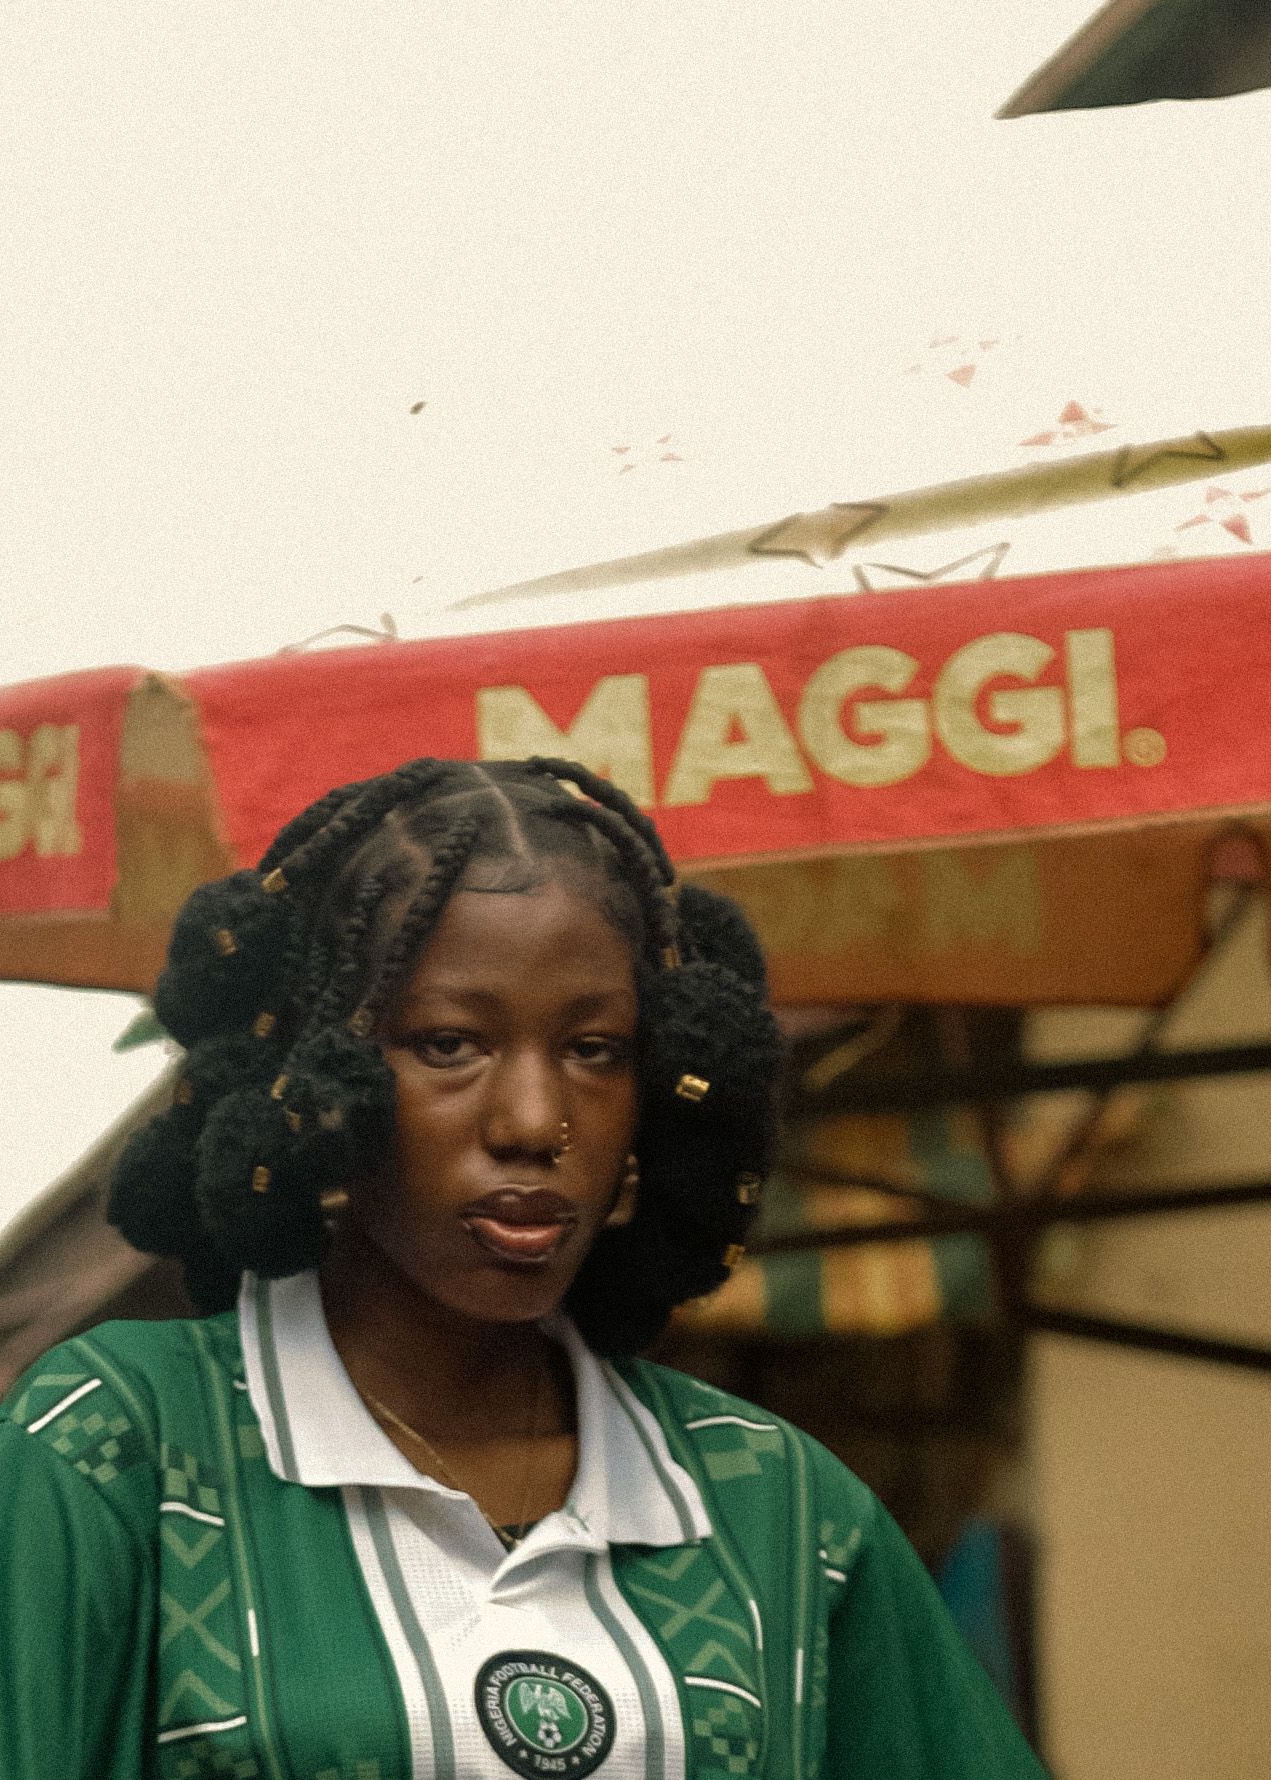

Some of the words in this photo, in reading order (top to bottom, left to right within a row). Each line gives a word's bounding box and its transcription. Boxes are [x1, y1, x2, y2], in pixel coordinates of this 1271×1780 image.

[475, 627, 1122, 811] MAGGI
[489, 1662, 561, 1688] FOOTBALL
[486, 1686, 517, 1747] NIGERIA
[561, 1671, 607, 1758] FEDERATION
[533, 1754, 567, 1772] 1945
